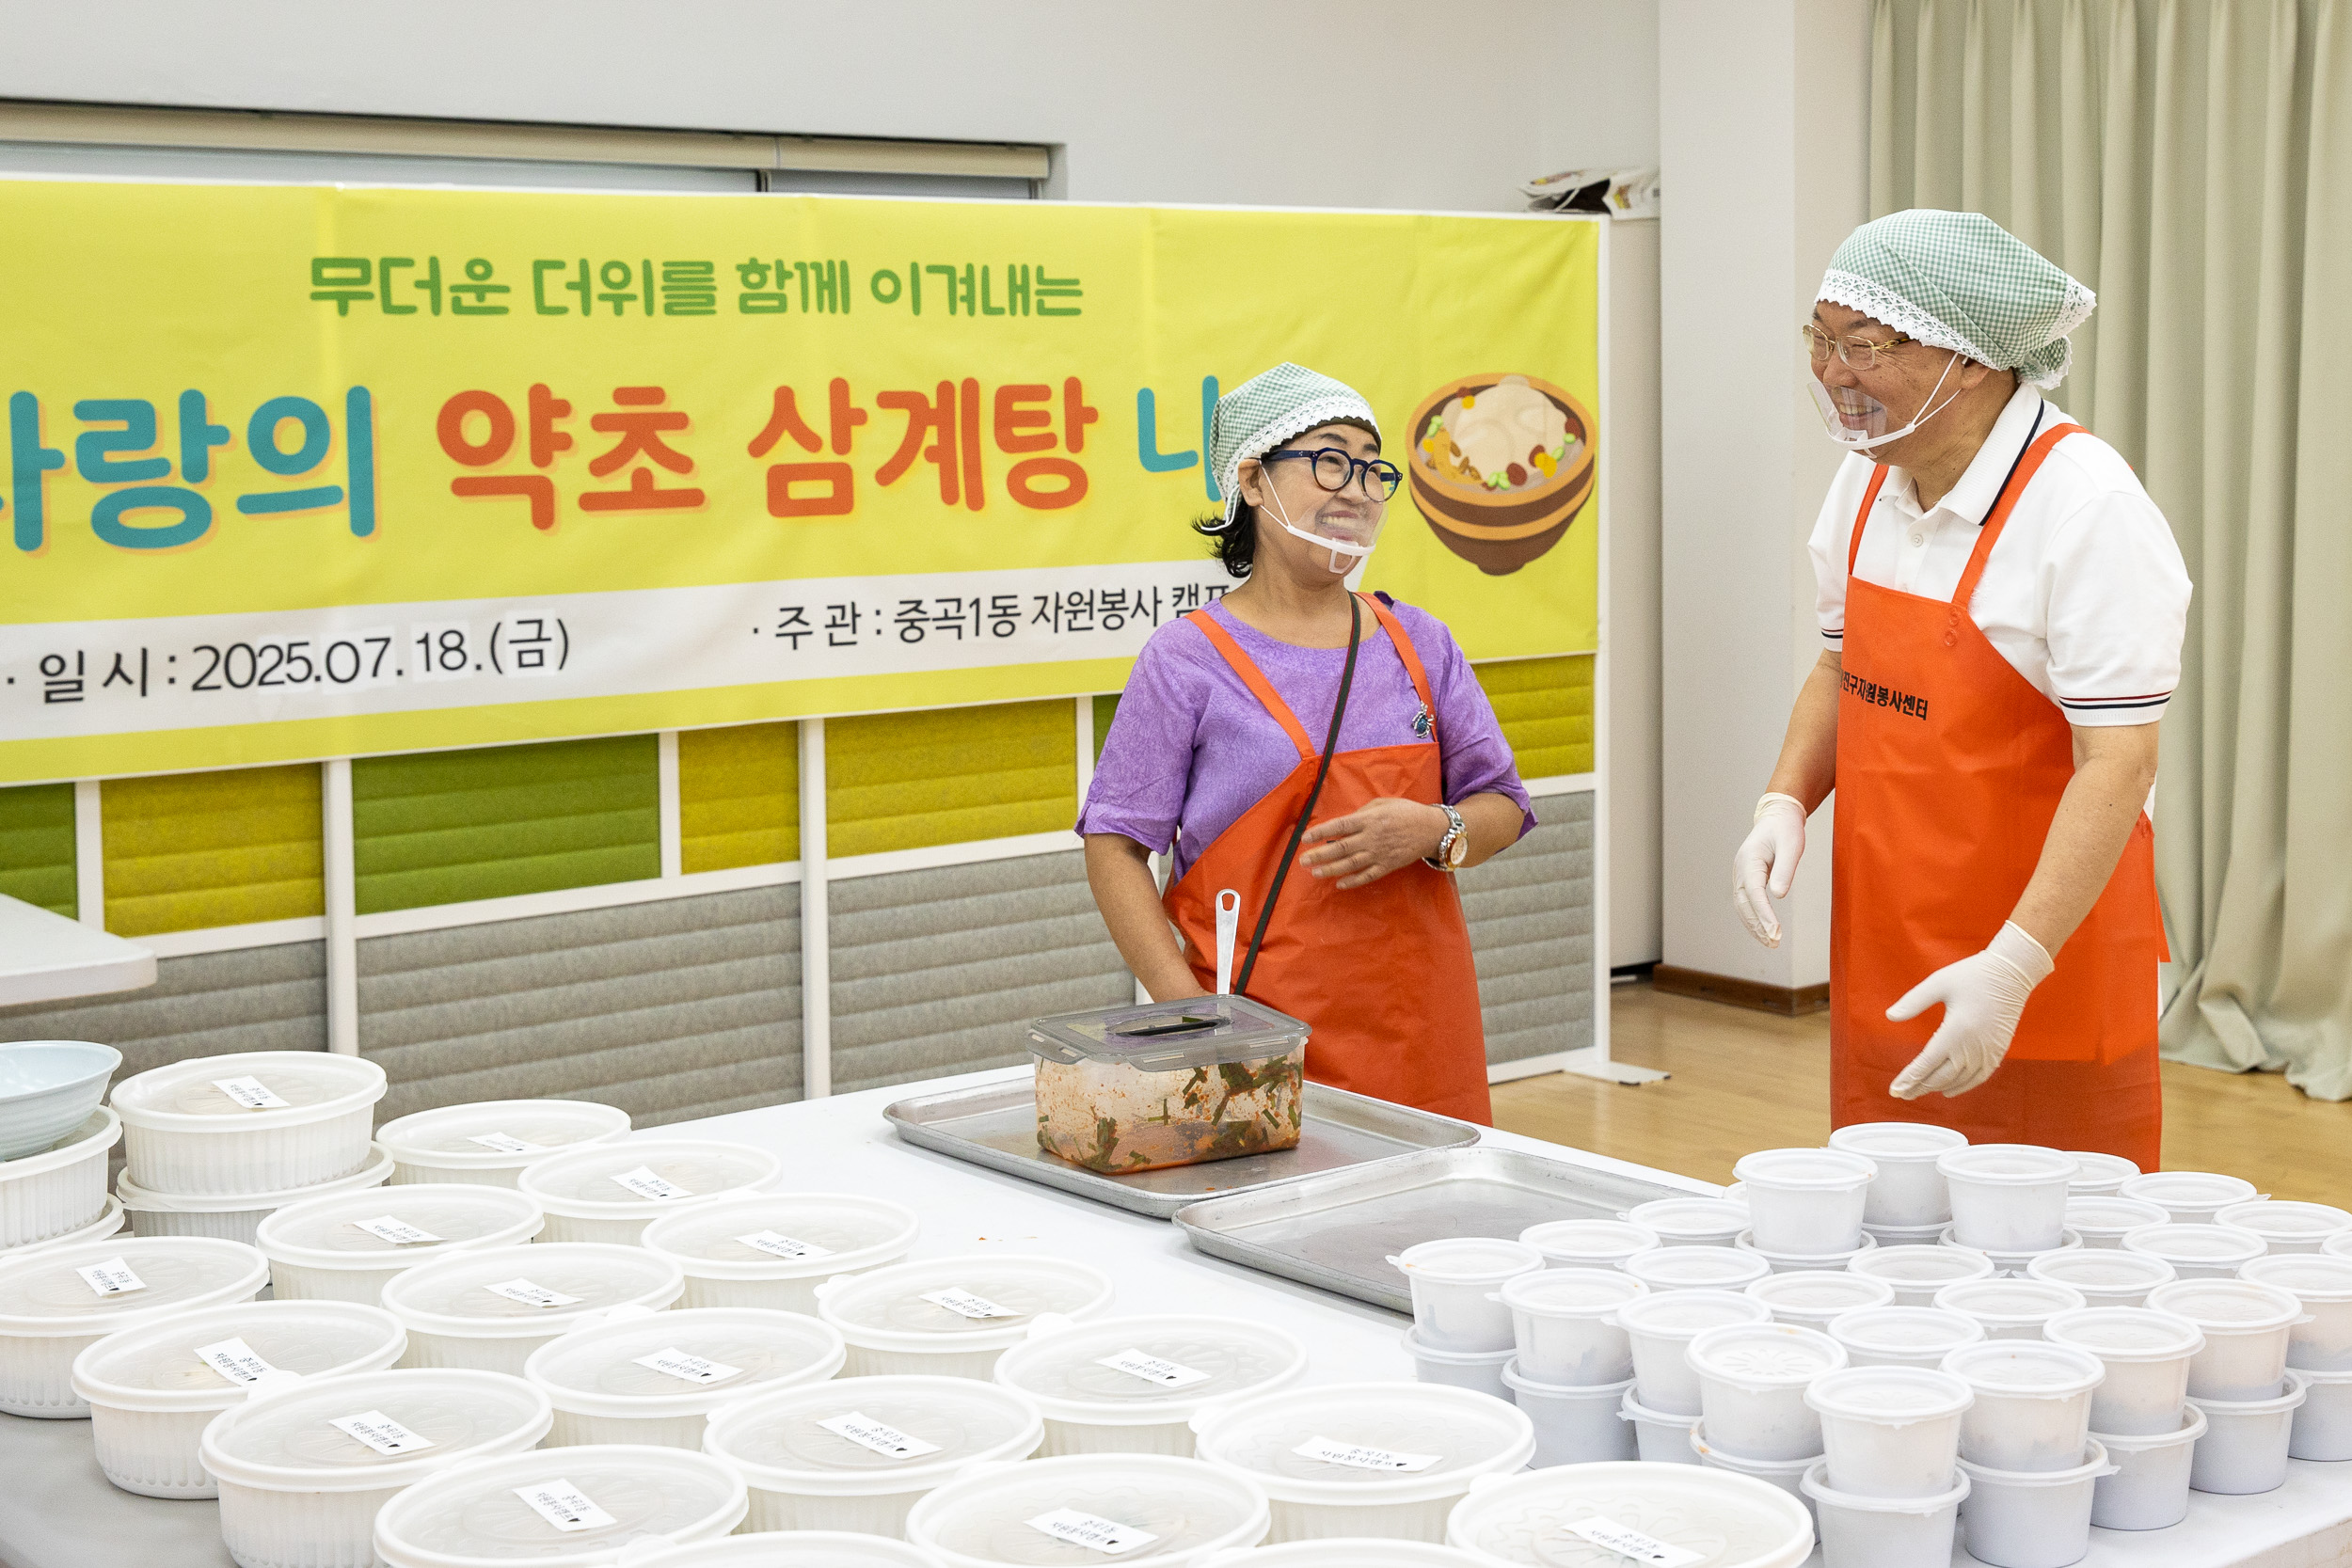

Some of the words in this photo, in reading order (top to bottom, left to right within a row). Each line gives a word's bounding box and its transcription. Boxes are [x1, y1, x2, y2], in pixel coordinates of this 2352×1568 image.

[310, 256, 513, 318] 무더운
[532, 258, 719, 318] 더위를
[736, 257, 851, 316] 함께
[870, 261, 1084, 318] 이겨내는
[436, 382, 707, 531] 약초
[747, 376, 1100, 518] 삼계탕
[894, 594, 1023, 644] 중곡1동
[1030, 585, 1163, 635] 자원봉사
[1840, 670, 1929, 721] 진구자원봉사센터
